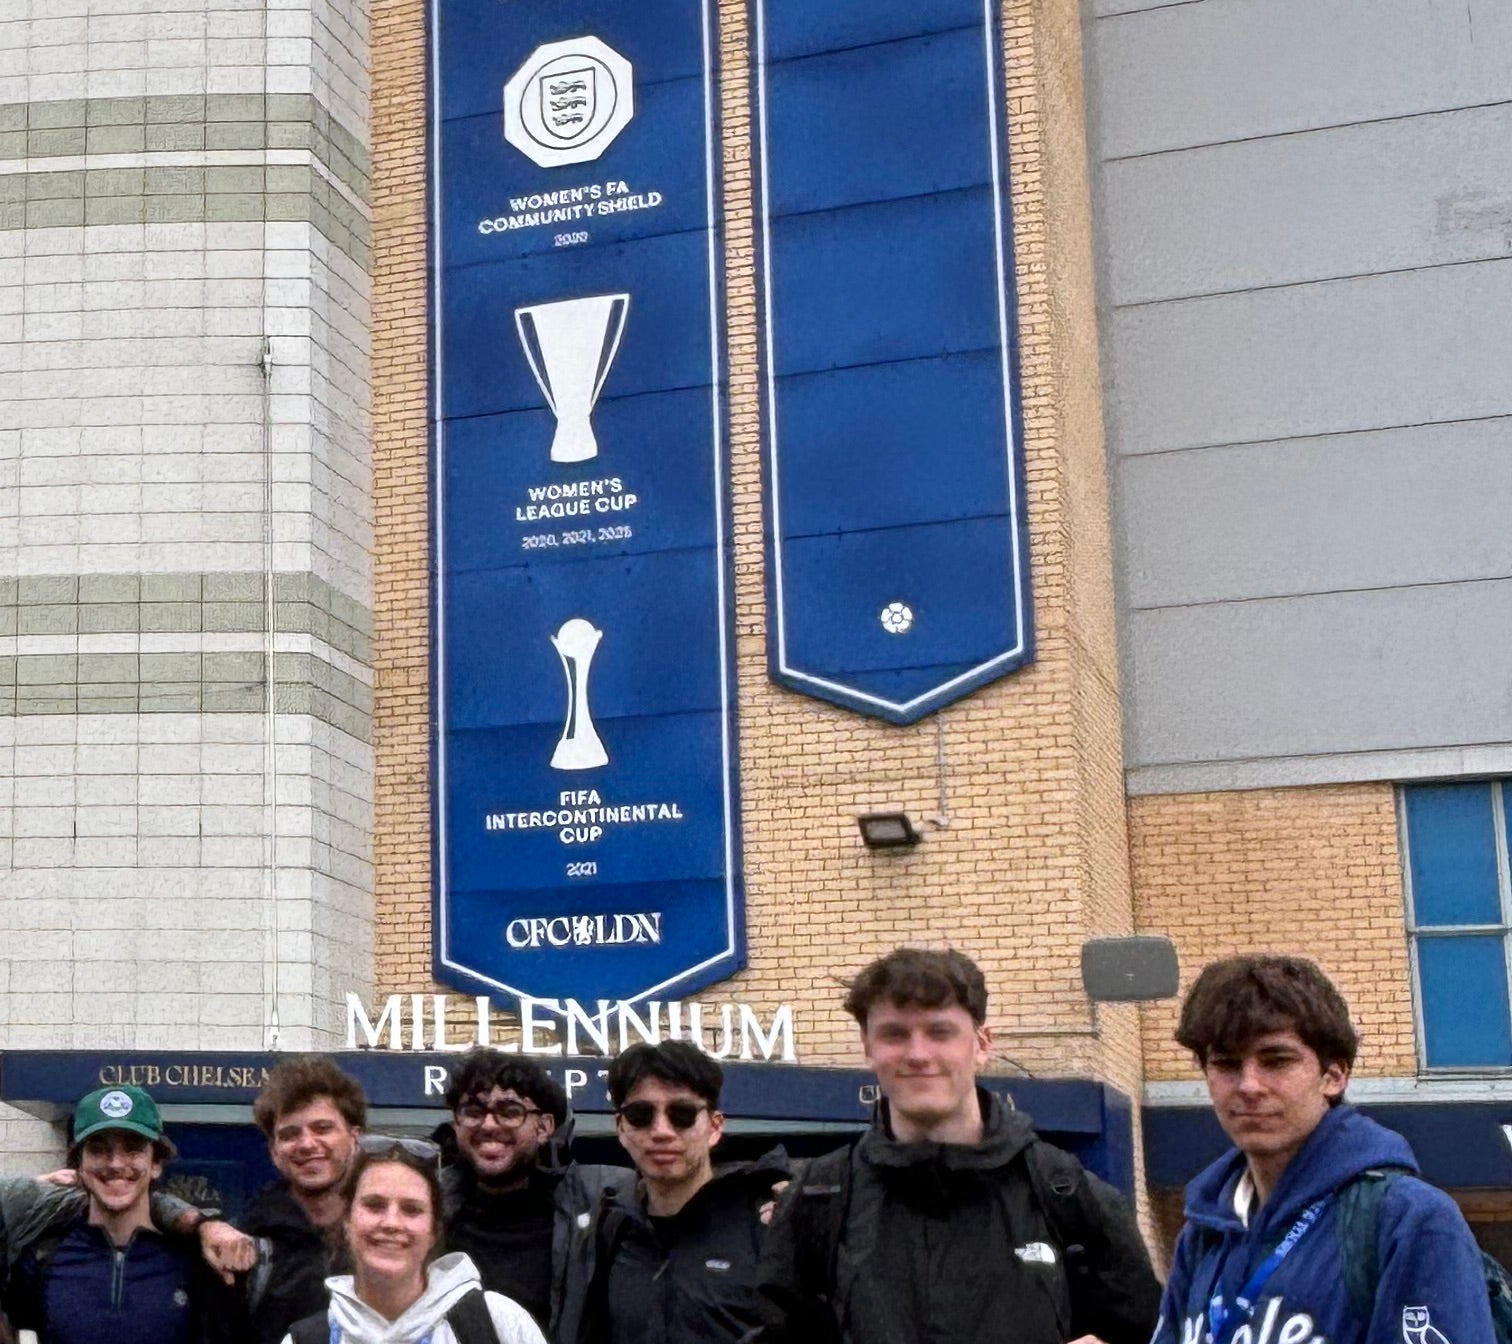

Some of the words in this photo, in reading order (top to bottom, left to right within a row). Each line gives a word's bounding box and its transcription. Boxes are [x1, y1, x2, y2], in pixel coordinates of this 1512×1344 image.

[509, 185, 601, 211] WOMEN'S
[606, 181, 629, 195] FA
[478, 203, 594, 234] COMMUNITY
[597, 192, 662, 215] SHIELD
[528, 478, 623, 502] WOMEN'S
[516, 500, 591, 521] LEAGUE
[595, 494, 638, 512] CUP
[560, 789, 602, 806] FIFA
[485, 803, 683, 830] INTERCONTINENTAL
[559, 826, 603, 844] CUP
[506, 917, 571, 948] CFC
[595, 912, 662, 944] LDN
[346, 992, 797, 1063] MILLENNIUM
[100, 1065, 161, 1086] CLUB
